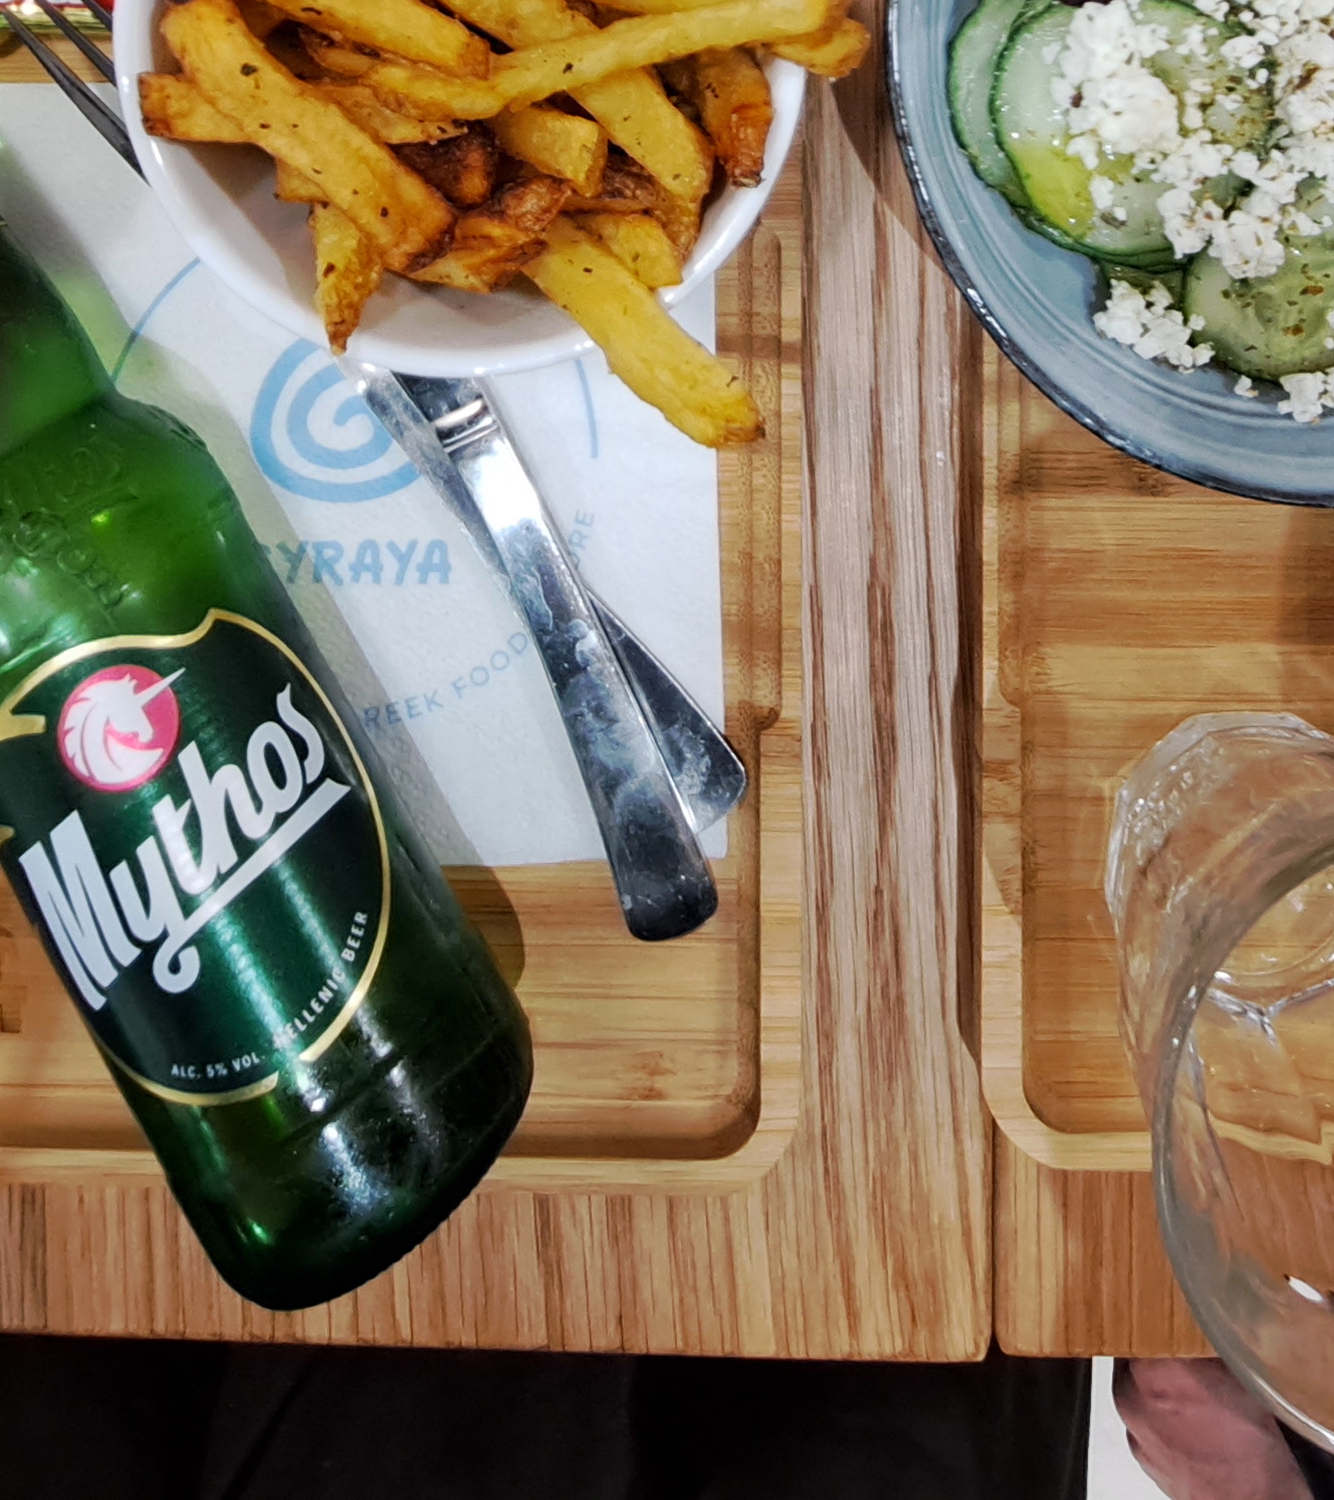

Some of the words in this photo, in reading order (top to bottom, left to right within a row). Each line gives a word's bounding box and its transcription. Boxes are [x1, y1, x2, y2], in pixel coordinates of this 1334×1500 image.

[364, 690, 444, 730] REEK
[451, 631, 528, 700] FOOD
[19, 683, 351, 1011] Mythos
[272, 964, 347, 1051] HELLENIC
[340, 910, 369, 963] BEER
[171, 1063, 202, 1079] ALC.
[206, 1062, 229, 1079] 5%
[232, 1051, 266, 1073] VOL.
